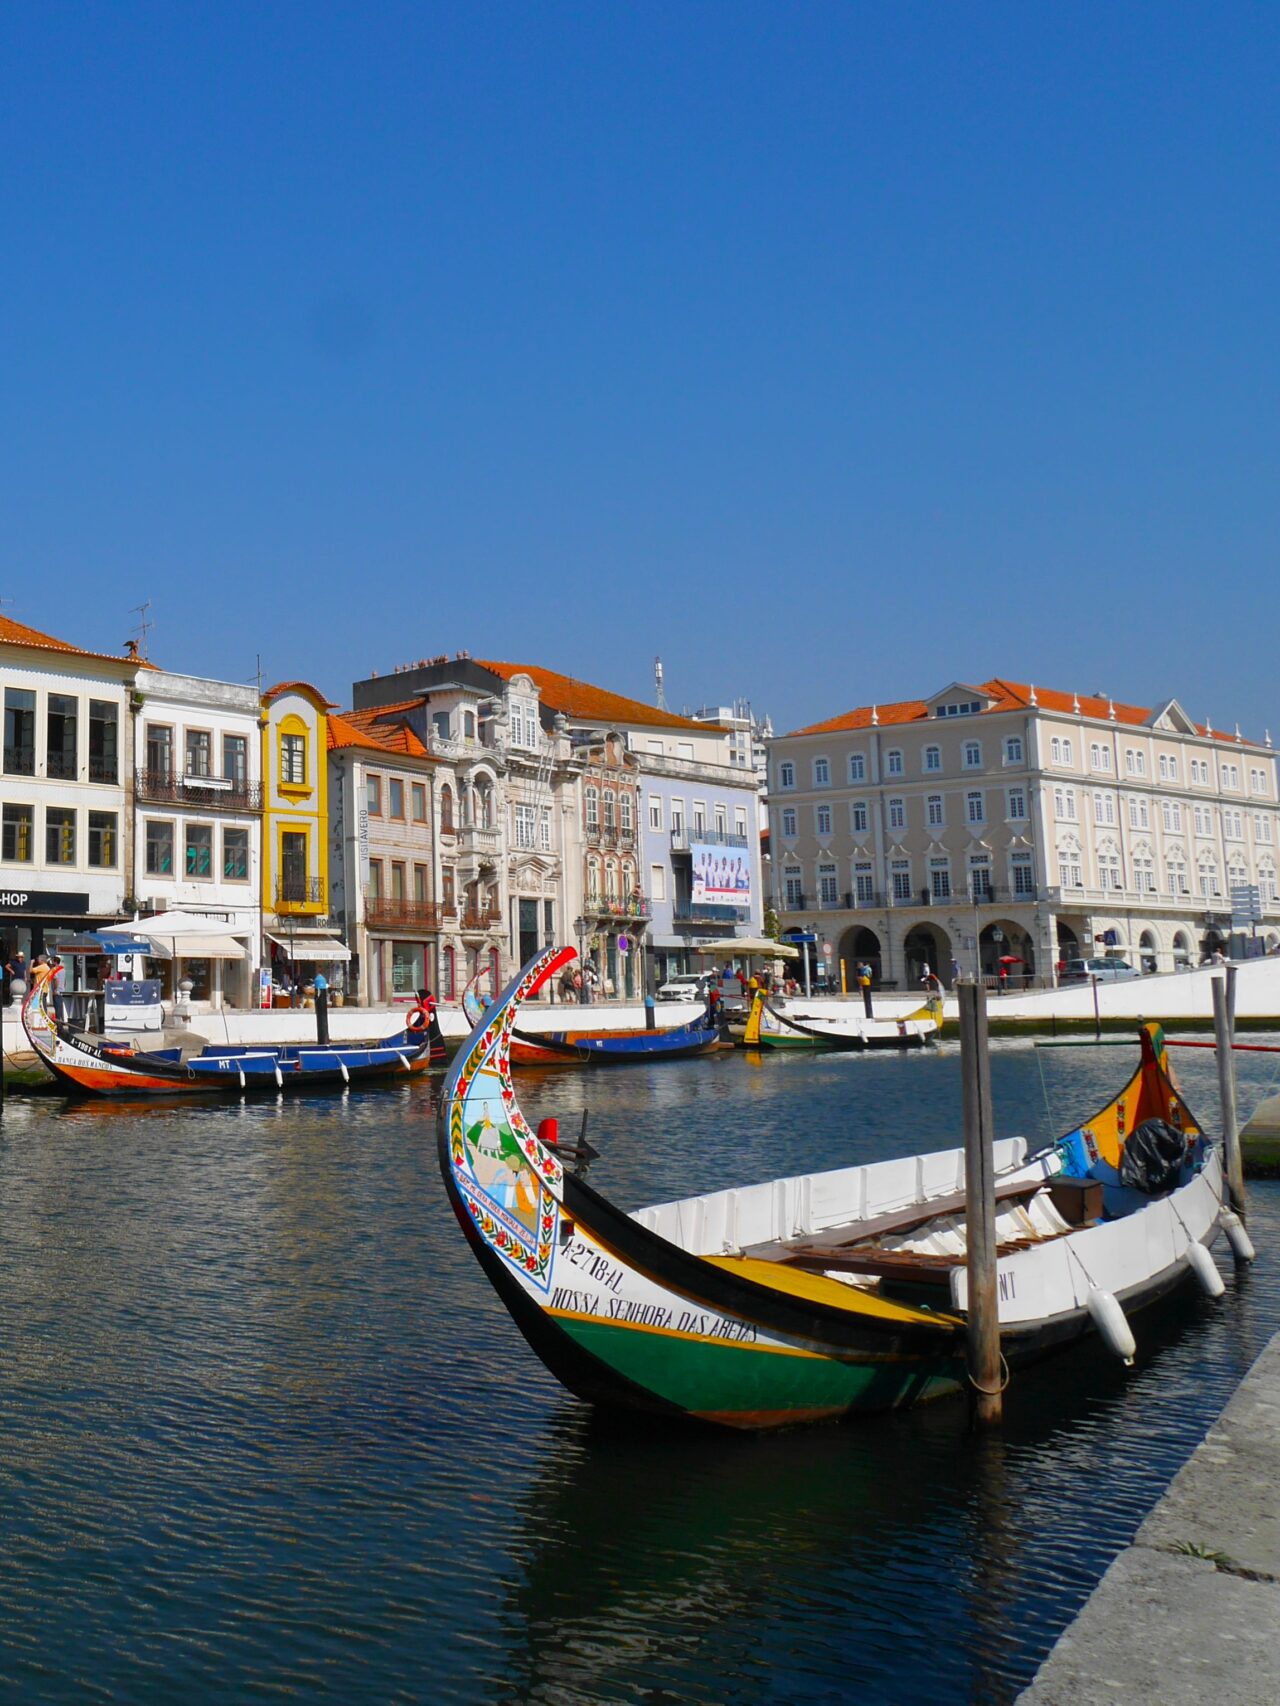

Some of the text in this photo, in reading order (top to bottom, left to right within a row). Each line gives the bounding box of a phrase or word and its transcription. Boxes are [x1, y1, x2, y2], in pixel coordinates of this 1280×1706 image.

[218, 1059, 231, 1069] MT
[561, 1238, 624, 1295] A-2718-AL
[550, 1286, 758, 1345] NOSSA SENHORA DAS AREIAS
